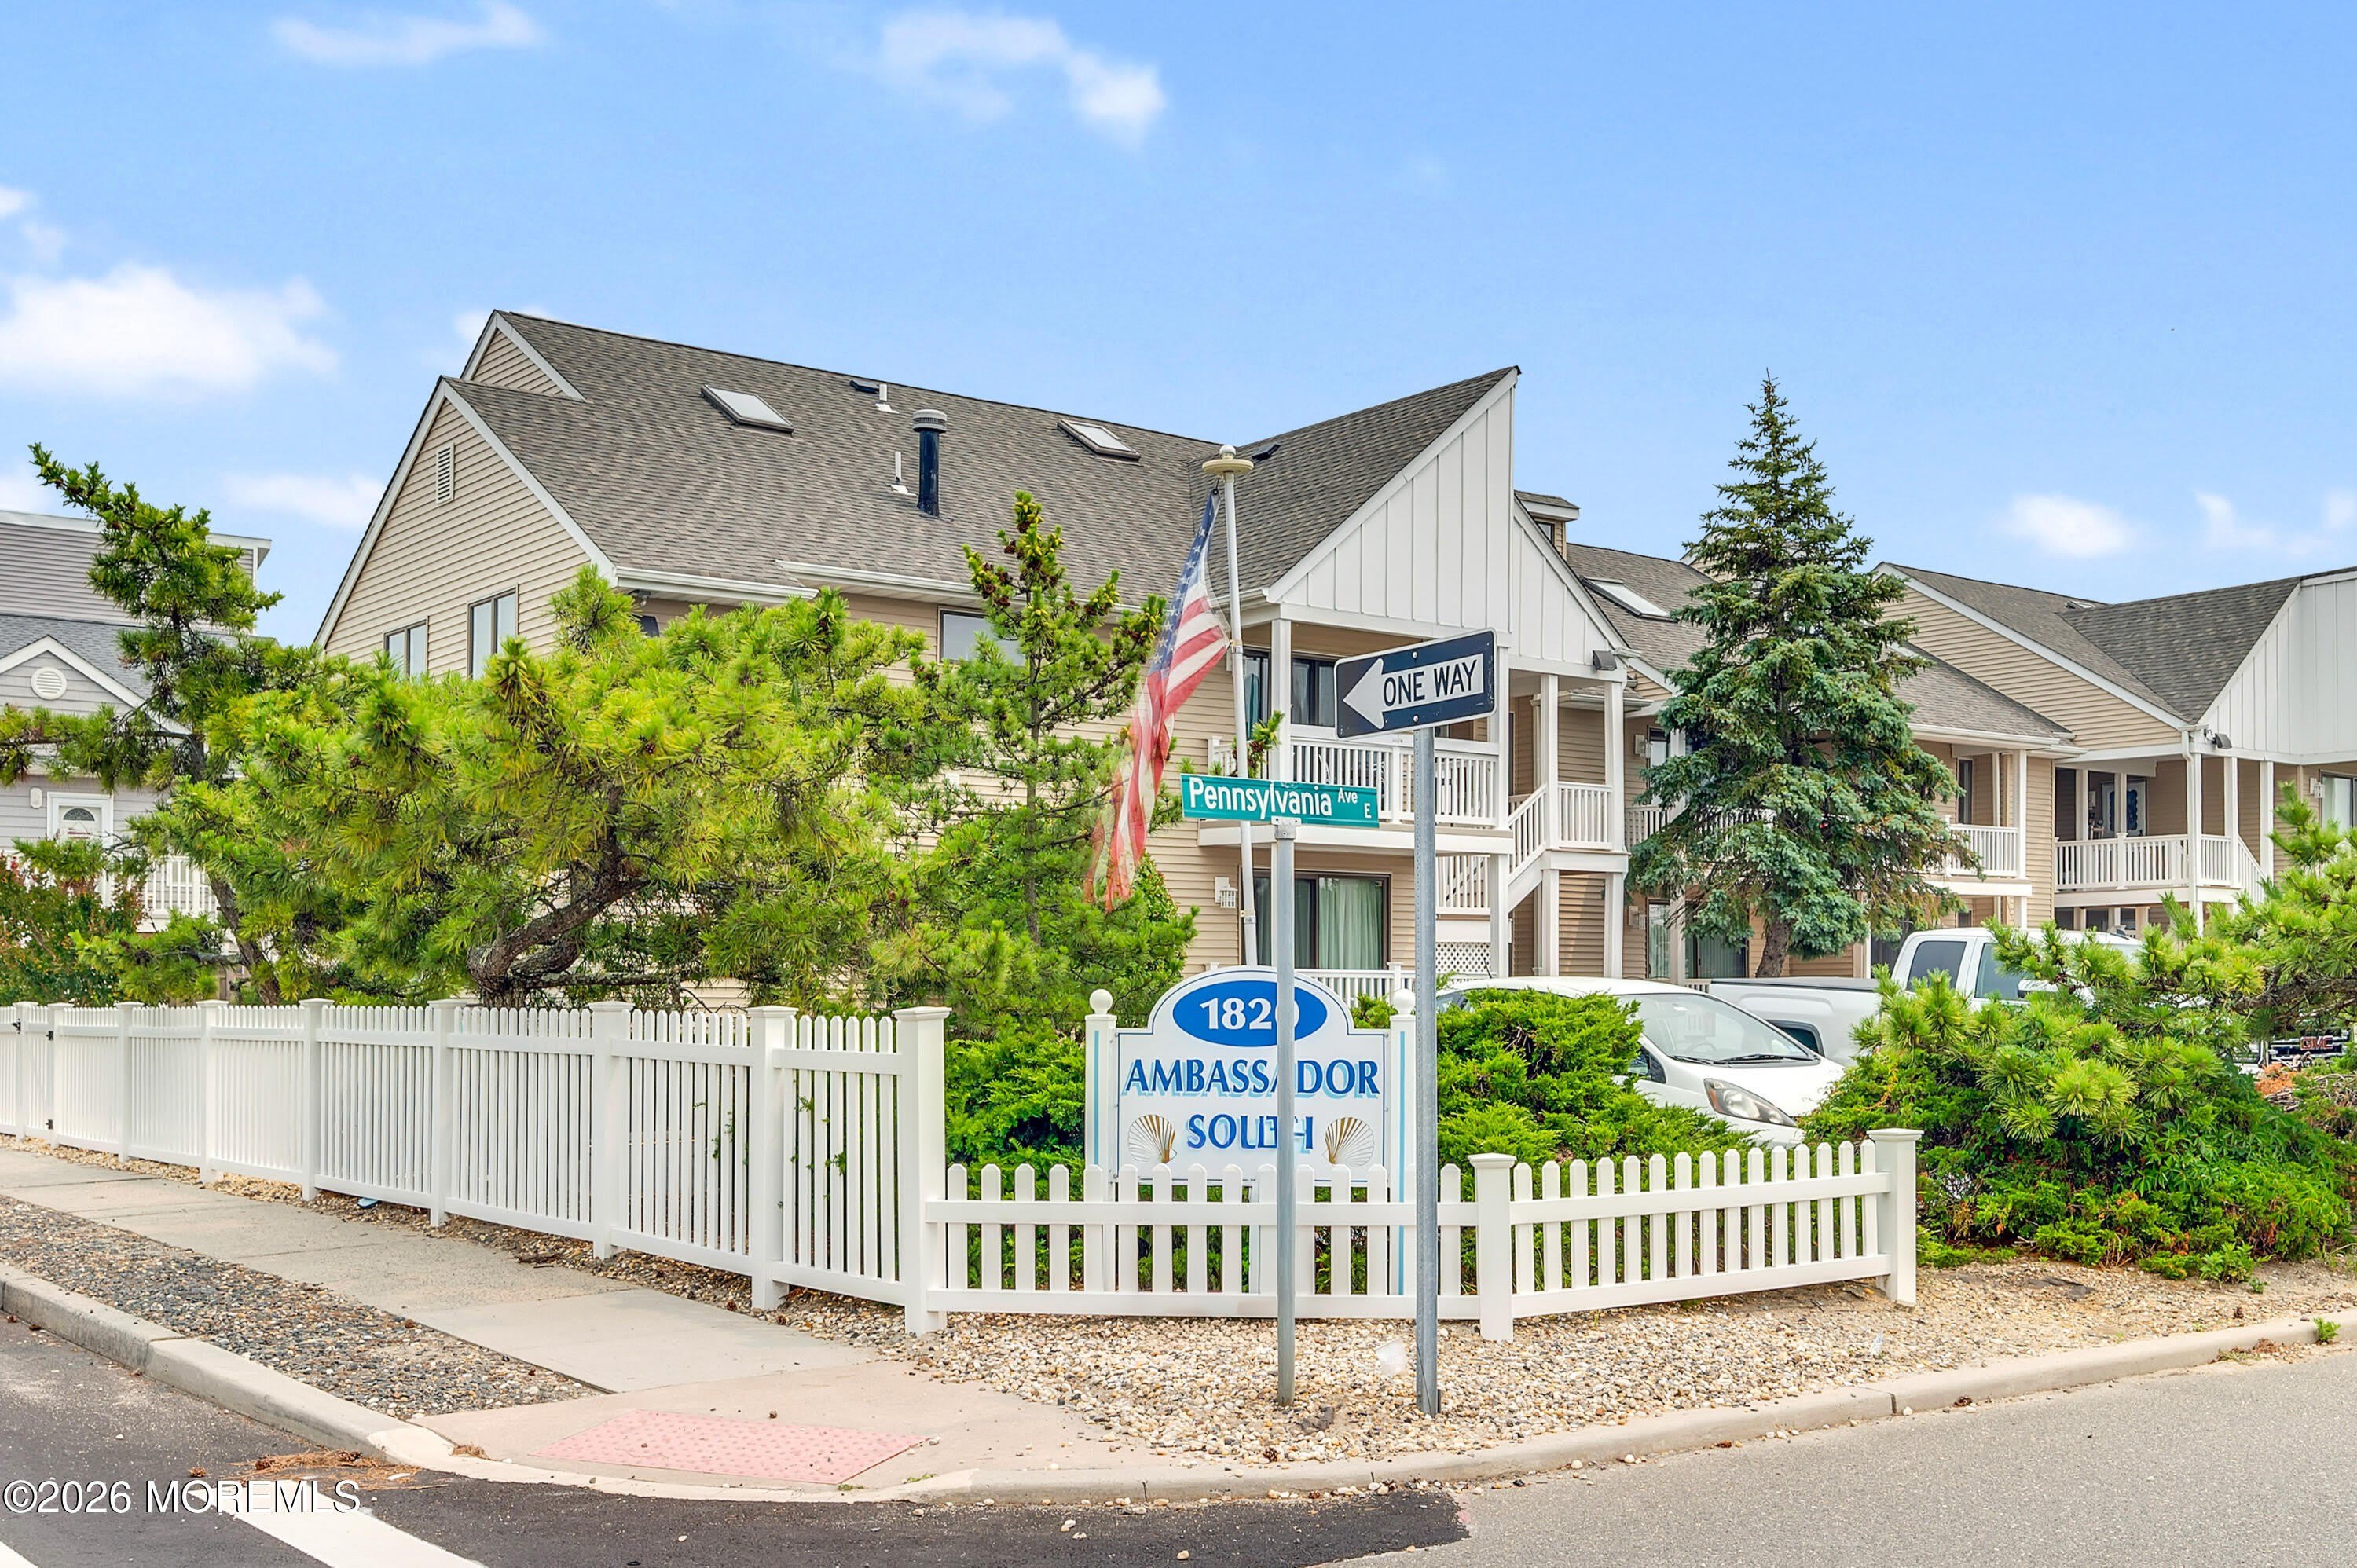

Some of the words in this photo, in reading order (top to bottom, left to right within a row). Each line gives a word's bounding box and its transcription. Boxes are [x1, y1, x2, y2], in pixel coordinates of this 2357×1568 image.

[1383, 671, 1425, 707] ONE
[1433, 659, 1478, 698] WAY
[1189, 777, 1332, 820] Pennsylvania
[1337, 787, 1358, 804] Ave
[1364, 802, 1372, 819] E
[2300, 1035, 2333, 1050] GMC
[1124, 1058, 1381, 1097] AMBASSDOR
